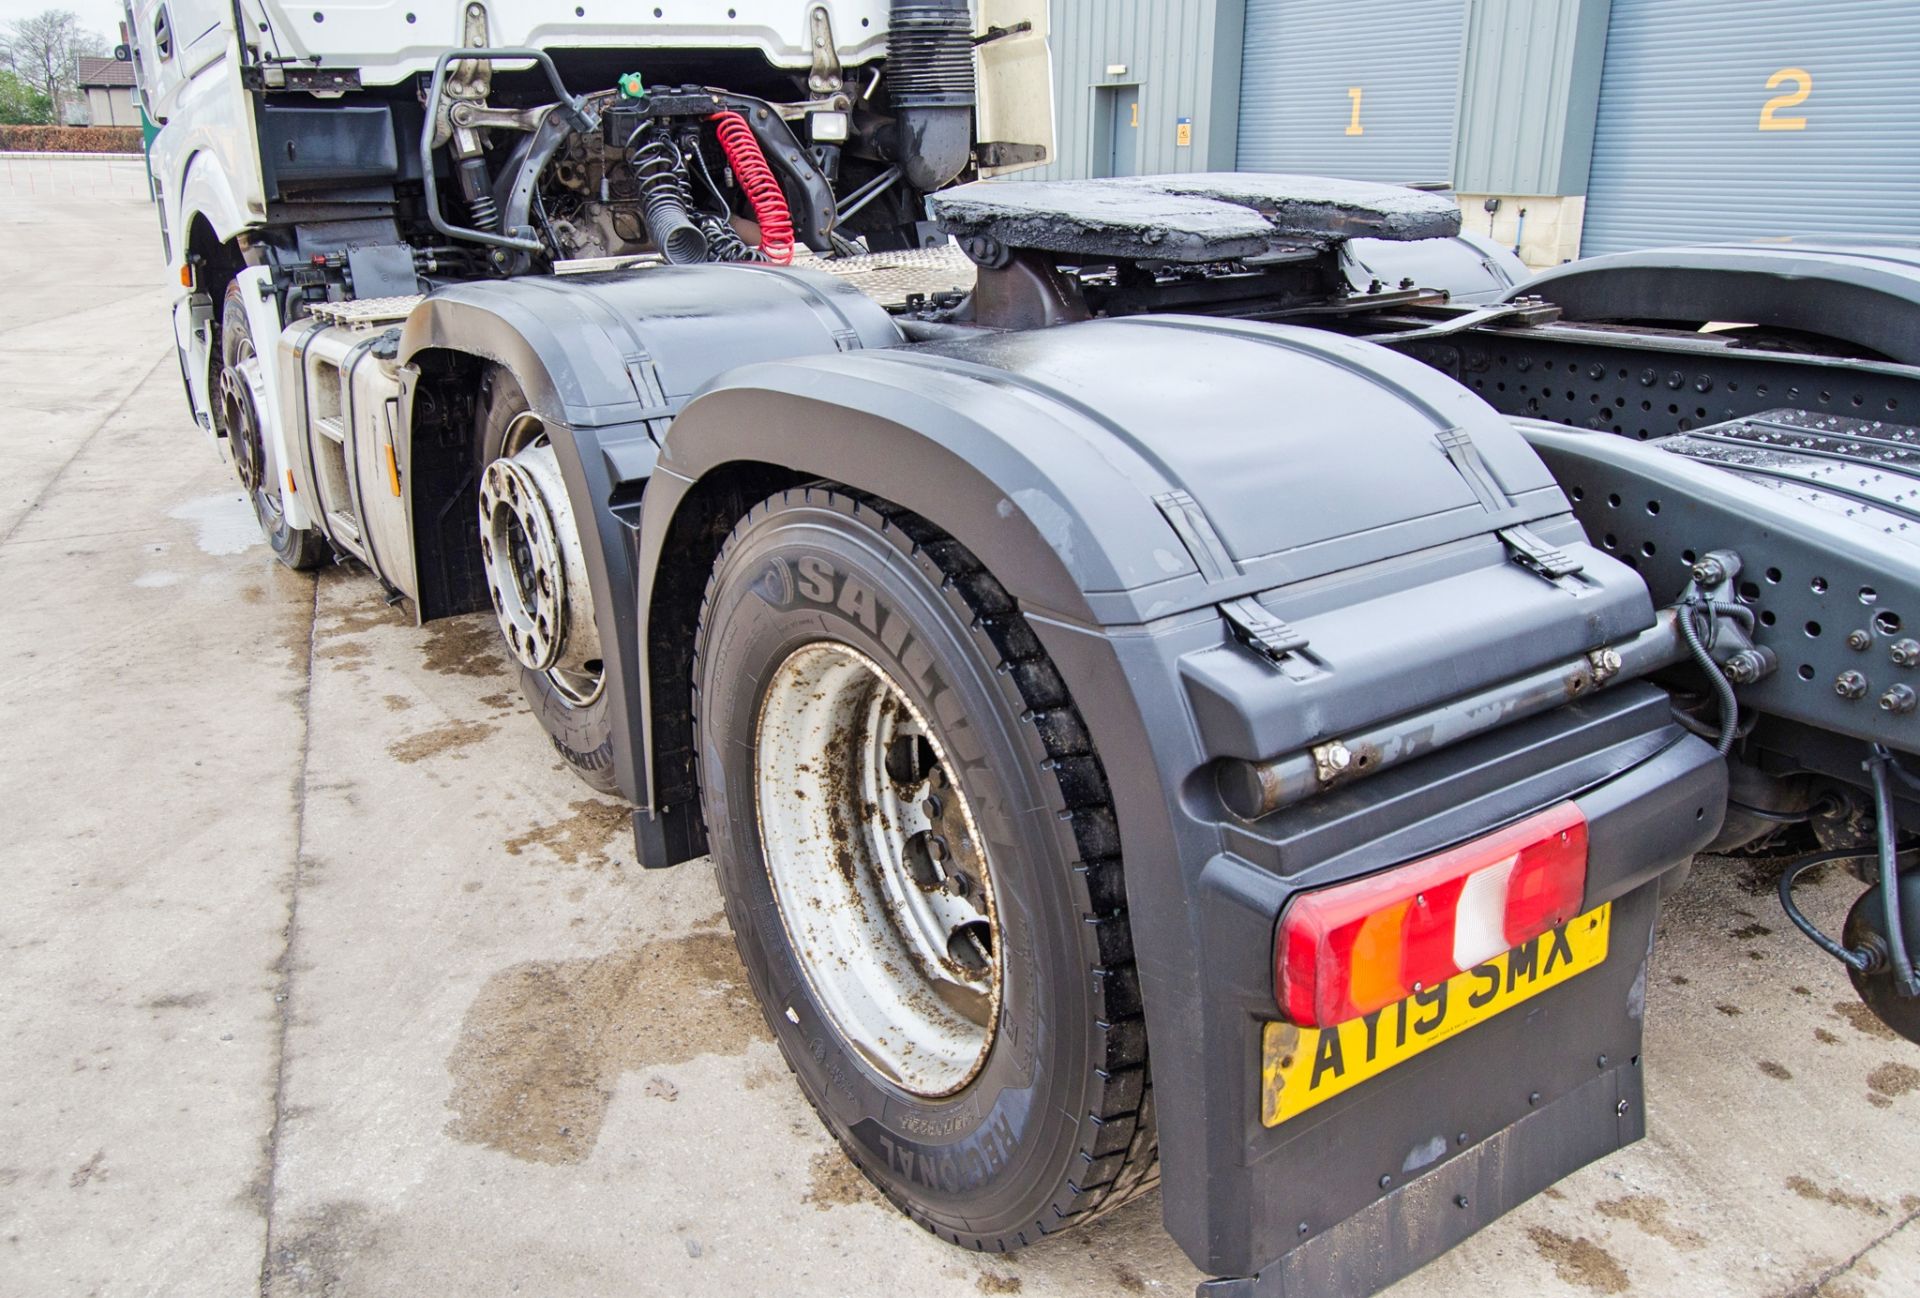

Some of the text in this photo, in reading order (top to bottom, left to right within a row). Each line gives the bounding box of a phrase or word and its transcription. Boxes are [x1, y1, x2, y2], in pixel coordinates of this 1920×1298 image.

[1130, 103, 1139, 128] 1
[1346, 87, 1363, 136] 1
[1759, 67, 1812, 131] 2
[1309, 924, 1573, 1091] AY19 SMX
